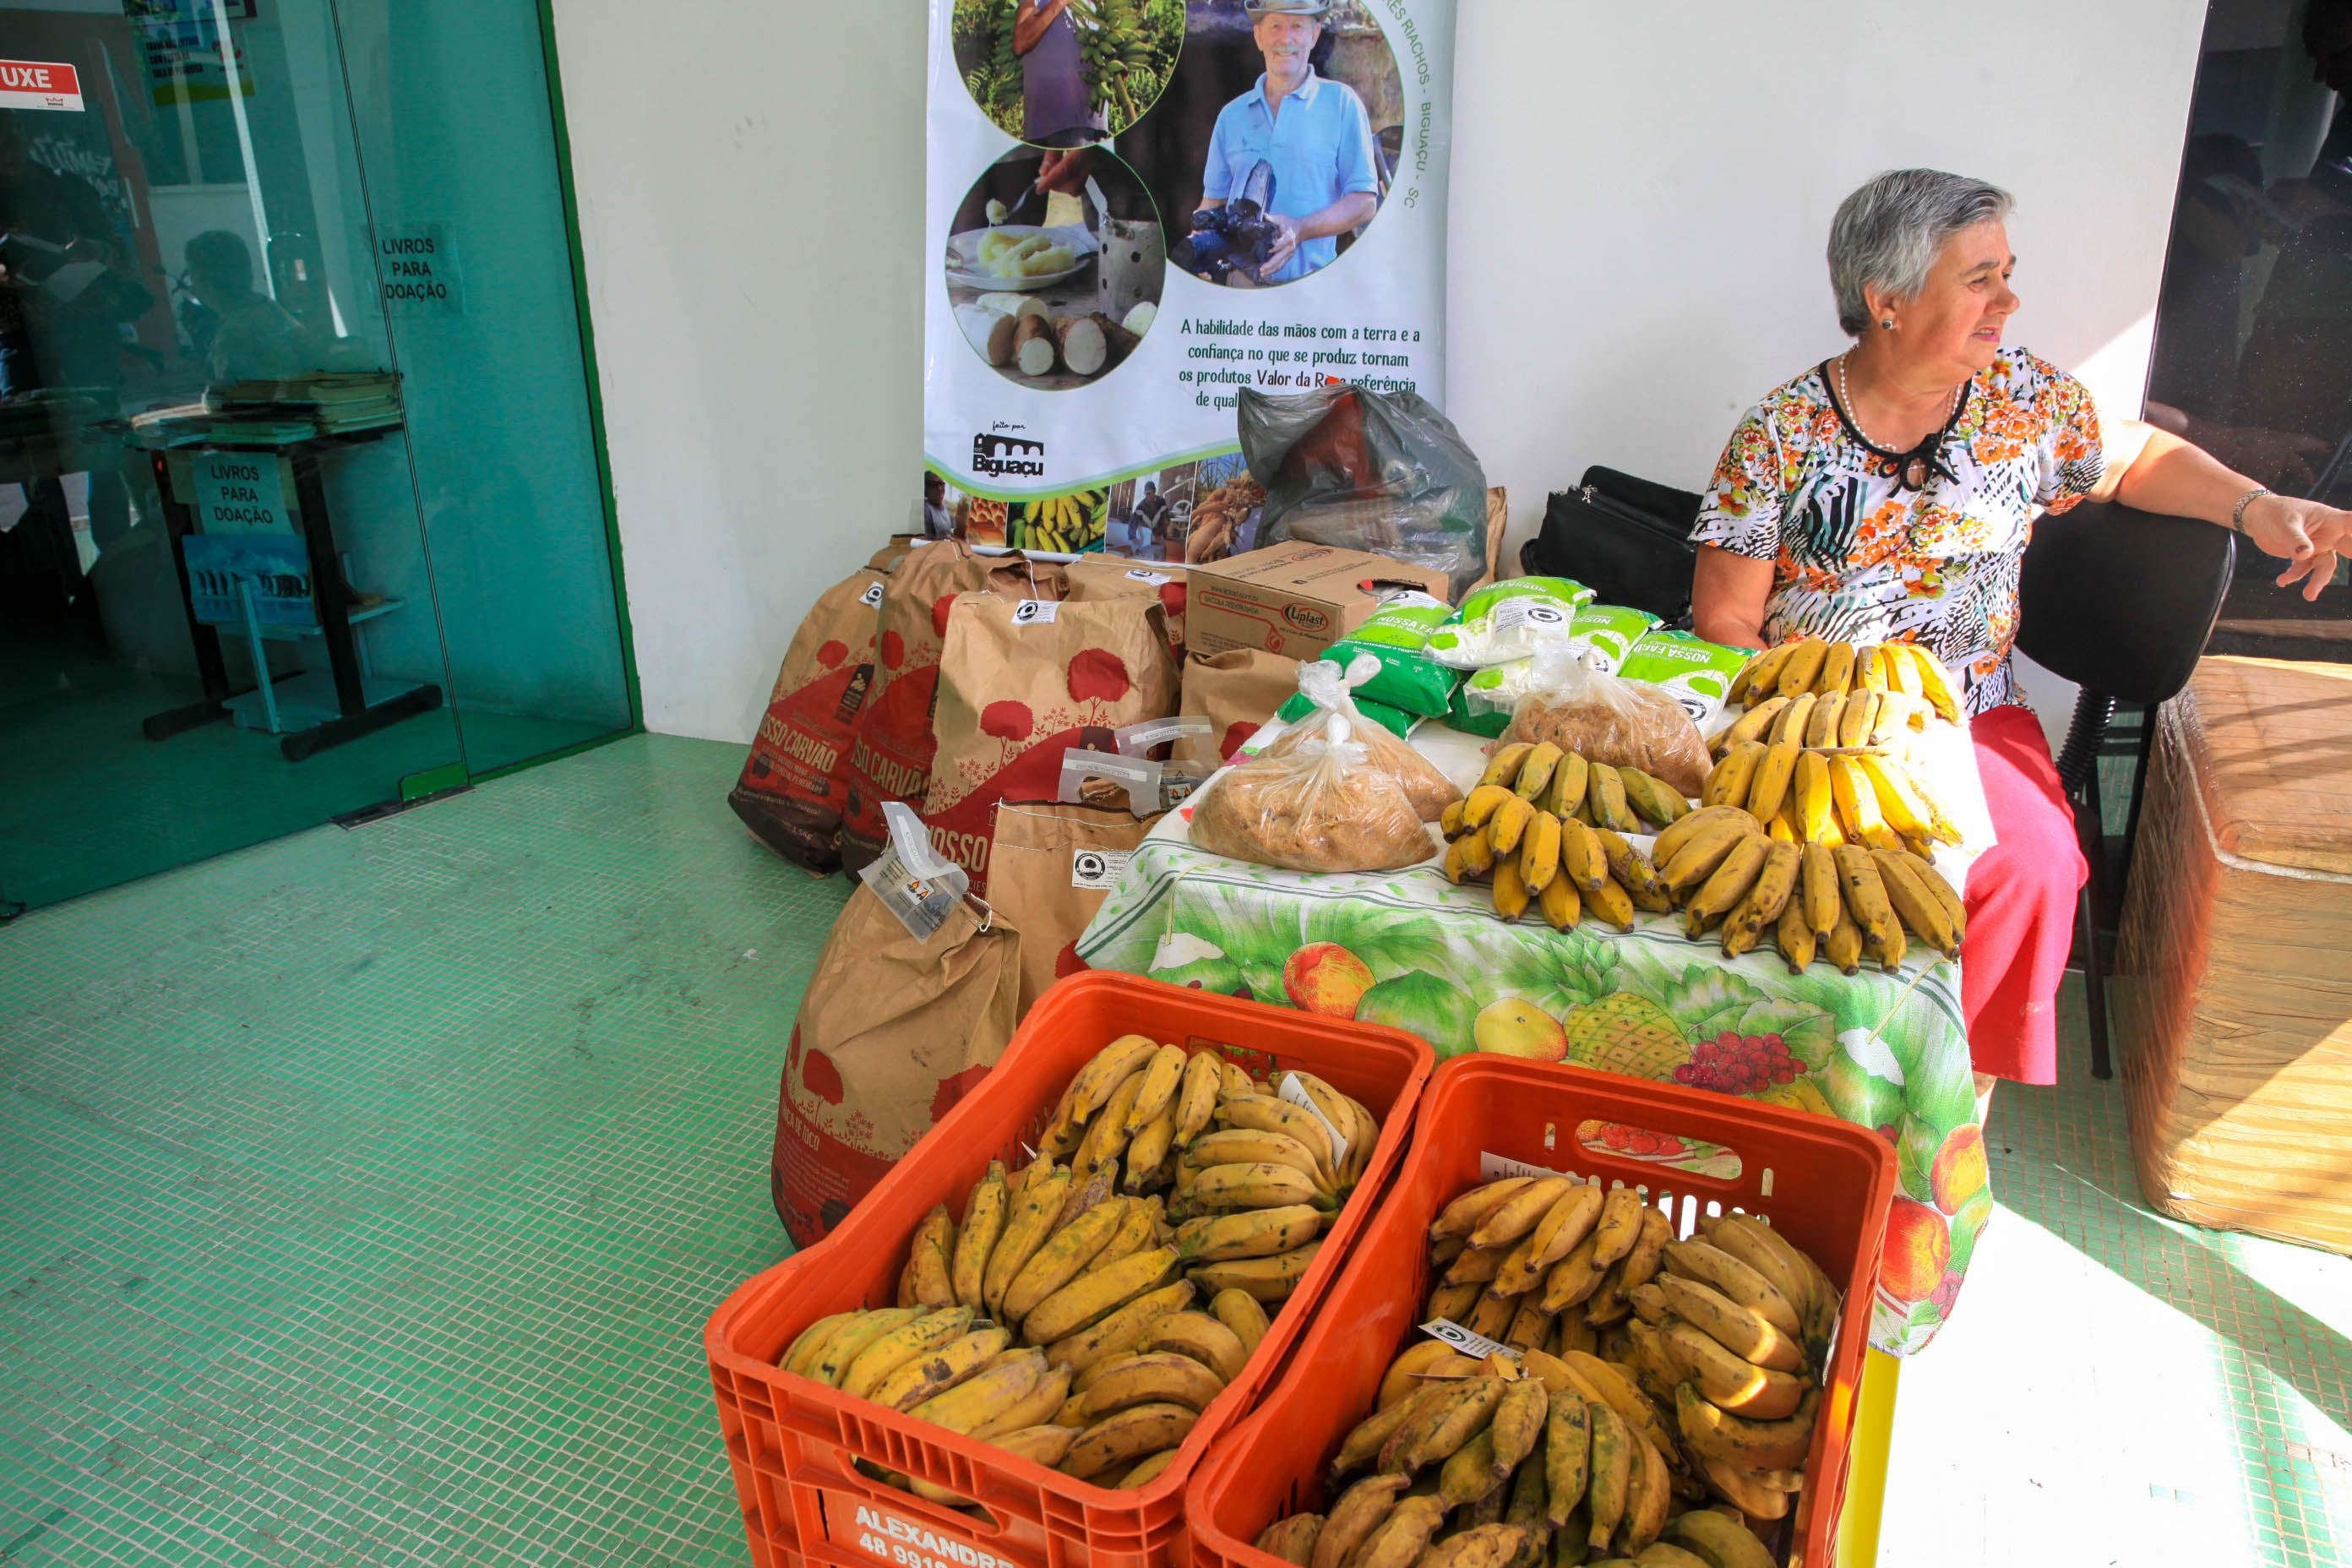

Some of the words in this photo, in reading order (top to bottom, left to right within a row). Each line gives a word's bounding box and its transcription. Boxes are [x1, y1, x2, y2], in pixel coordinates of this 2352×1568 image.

[1401, 19, 1429, 84] RIACHOS
[1416, 101, 1431, 172] BIGUAÇU
[1404, 188, 1419, 209] SC
[382, 238, 435, 254] LIVROS
[392, 261, 433, 277] PARA
[384, 280, 447, 302] DOAÇÃO
[1181, 318, 1191, 335] A
[1196, 319, 1254, 337] habilidade
[1258, 321, 1279, 337] das
[1283, 324, 1316, 339] mãos
[1320, 326, 1348, 340] com
[1352, 327, 1359, 340] a
[1364, 325, 1396, 341] terra
[1401, 329, 1408, 341] e
[1413, 329, 1420, 343] a
[1188, 343, 1244, 362] confiança
[1248, 348, 1263, 361] no
[1268, 349, 1289, 368] que
[1294, 350, 1308, 362] se
[1312, 348, 1357, 368] produz
[1362, 351, 1409, 367] tornam
[1179, 369, 1193, 382] os
[1196, 368, 1252, 387] produtos
[1257, 369, 1292, 387] Valor
[1295, 371, 1310, 388] da
[1351, 374, 1417, 393] referência
[1195, 391, 1210, 406] de
[992, 421, 1010, 432] feito
[1011, 423, 1026, 432] por
[210, 464, 260, 481] LIVROS
[972, 454, 1043, 478] Biguaçu
[221, 486, 259, 502] PARA
[214, 505, 274, 525] DOAÇÃO
[1291, 607, 1326, 624] Liplast
[1668, 649, 1711, 663] NOSSA
[783, 728, 837, 774] CARVÃO
[859, 1533, 888, 1557] 48
